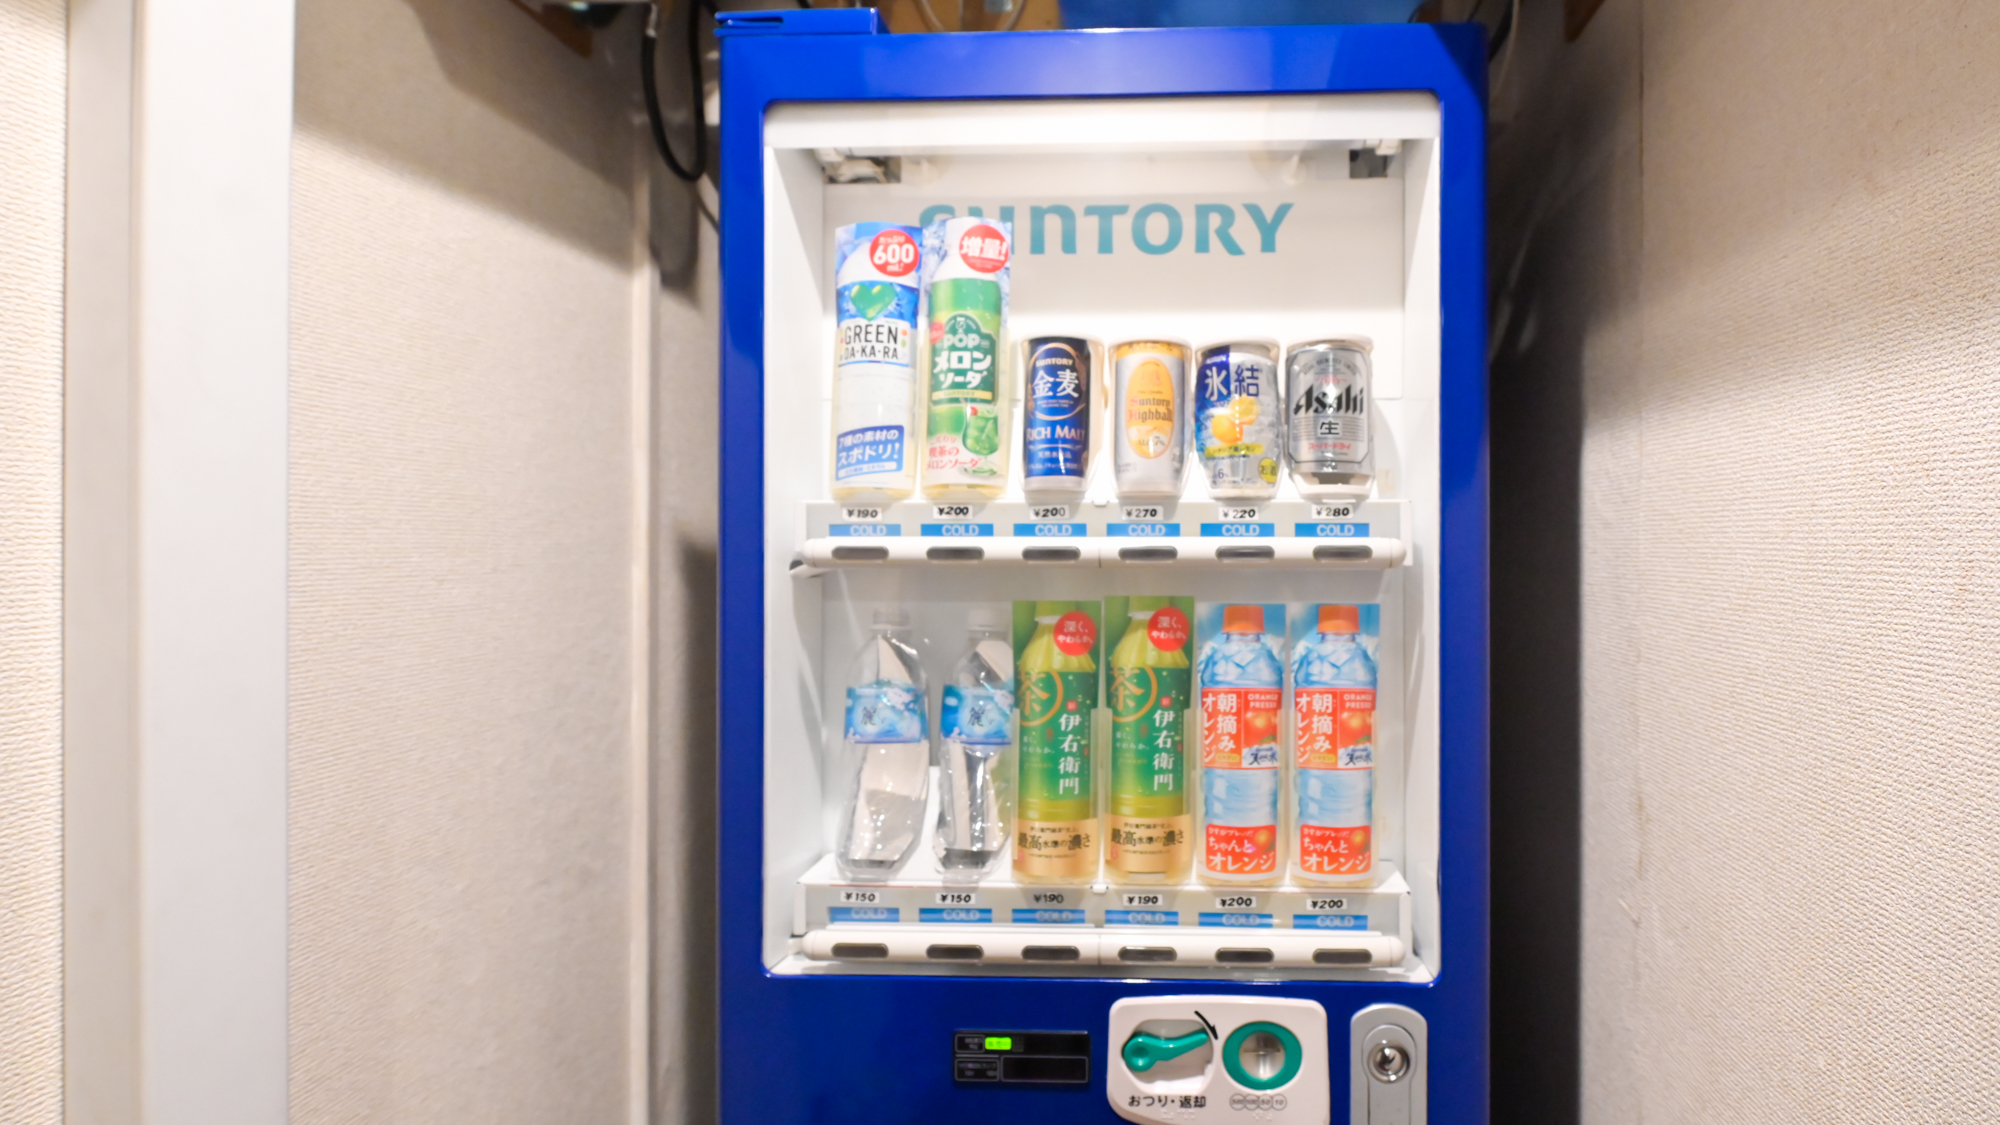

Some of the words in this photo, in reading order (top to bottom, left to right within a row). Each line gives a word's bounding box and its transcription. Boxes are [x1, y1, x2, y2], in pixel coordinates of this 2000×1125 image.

[873, 243, 915, 265] 600
[960, 236, 1008, 261] 増量!
[845, 324, 899, 345] GREEN
[942, 333, 981, 348] POP
[933, 351, 993, 373] メロン
[1036, 357, 1073, 367] SUNTORY
[939, 370, 988, 389] ソーダ
[1033, 369, 1080, 398] 金麦
[1205, 365, 1260, 401] 氷結
[1130, 397, 1170, 407] Suntory
[1293, 383, 1364, 415] Asahi
[1128, 408, 1173, 422] Highball
[1320, 420, 1340, 435] 生
[838, 442, 900, 467] スポドリ!
[847, 509, 878, 518] ¥190
[938, 506, 969, 516] ¥200
[1033, 507, 1066, 517] ¥200
[1125, 508, 1157, 517] ¥270
[1222, 509, 1255, 518] ¥220
[1316, 506, 1349, 516] ¥280
[850, 525, 886, 536] COLD
[942, 525, 979, 536] COLD
[1035, 525, 1072, 536] COLD
[1128, 524, 1165, 536] COLD
[1222, 524, 1259, 536] COLD
[1316, 524, 1353, 536] COLD
[1217, 692, 1237, 752] 朝摘み
[1312, 692, 1333, 752] 朝摘み
[1058, 714, 1082, 794] 伊右衛門
[1153, 709, 1176, 791] 伊右衛門
[1018, 832, 1091, 852] 最高水準の濃さ
[1111, 828, 1184, 848] 最高水準の濃さ
[1208, 837, 1252, 854] ちゃんと
[1303, 837, 1349, 854] ちゃんと
[1208, 852, 1275, 871] オレンジ
[1303, 852, 1370, 871] オレンジ
[845, 892, 876, 902] ¥150
[940, 894, 971, 903] ¥150
[1034, 894, 1064, 903] ¥190
[1127, 895, 1158, 905] ¥190
[1219, 896, 1252, 907] ¥200
[1311, 899, 1343, 909] ¥200
[851, 908, 887, 919] COLD
[942, 909, 979, 920] COLD
[1036, 910, 1072, 921] COLD
[1128, 912, 1165, 923] COLD
[1222, 914, 1259, 925] COLD
[1316, 915, 1353, 927] COLD
[1128, 1095, 1206, 1109] おつり・返却
